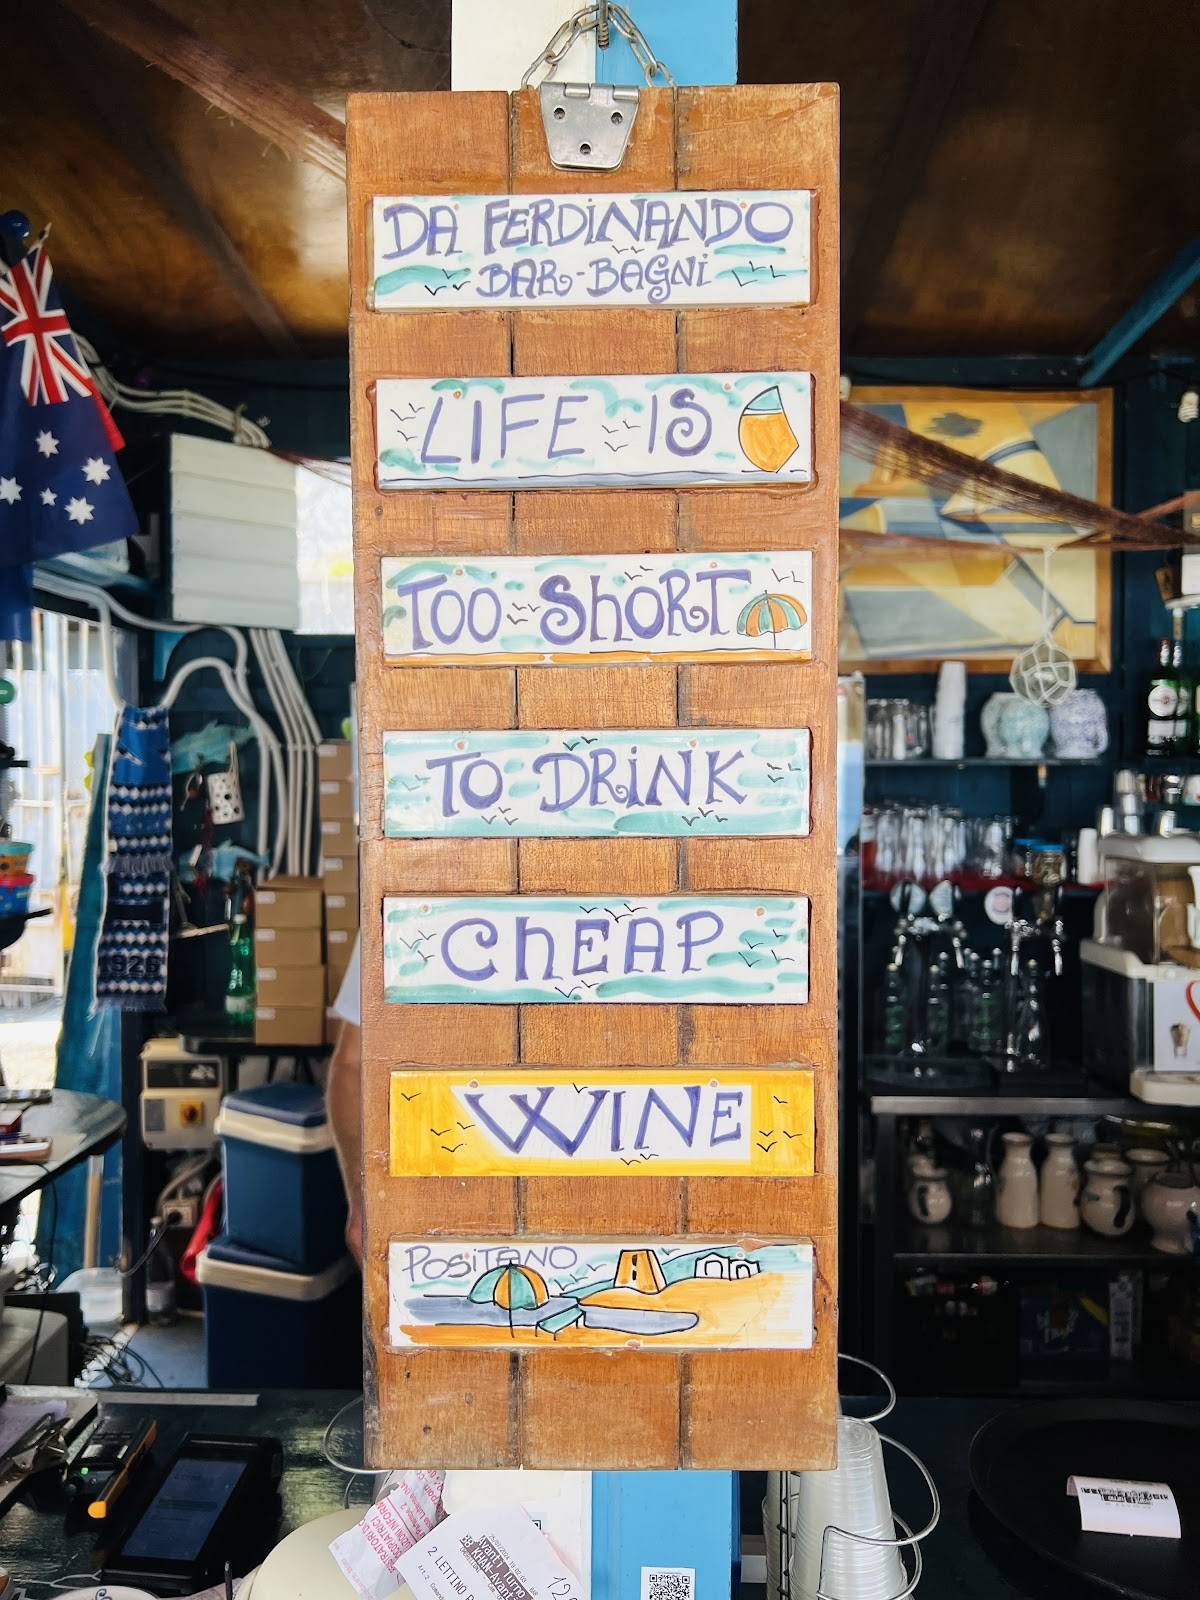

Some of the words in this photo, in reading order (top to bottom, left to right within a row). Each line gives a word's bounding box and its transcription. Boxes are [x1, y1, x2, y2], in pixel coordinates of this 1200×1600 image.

[381, 203, 462, 260] DA
[420, 393, 589, 464] LIFE
[647, 389, 712, 457] IS
[397, 575, 502, 650] TOO
[426, 751, 503, 817] TO
[464, 1085, 744, 1157] WINE
[428, 1546, 438, 1557] 2
[434, 1556, 467, 1595] LETTINO
[480, 1534, 503, 1567] Avanti
[504, 1571, 526, 1598] Turno
